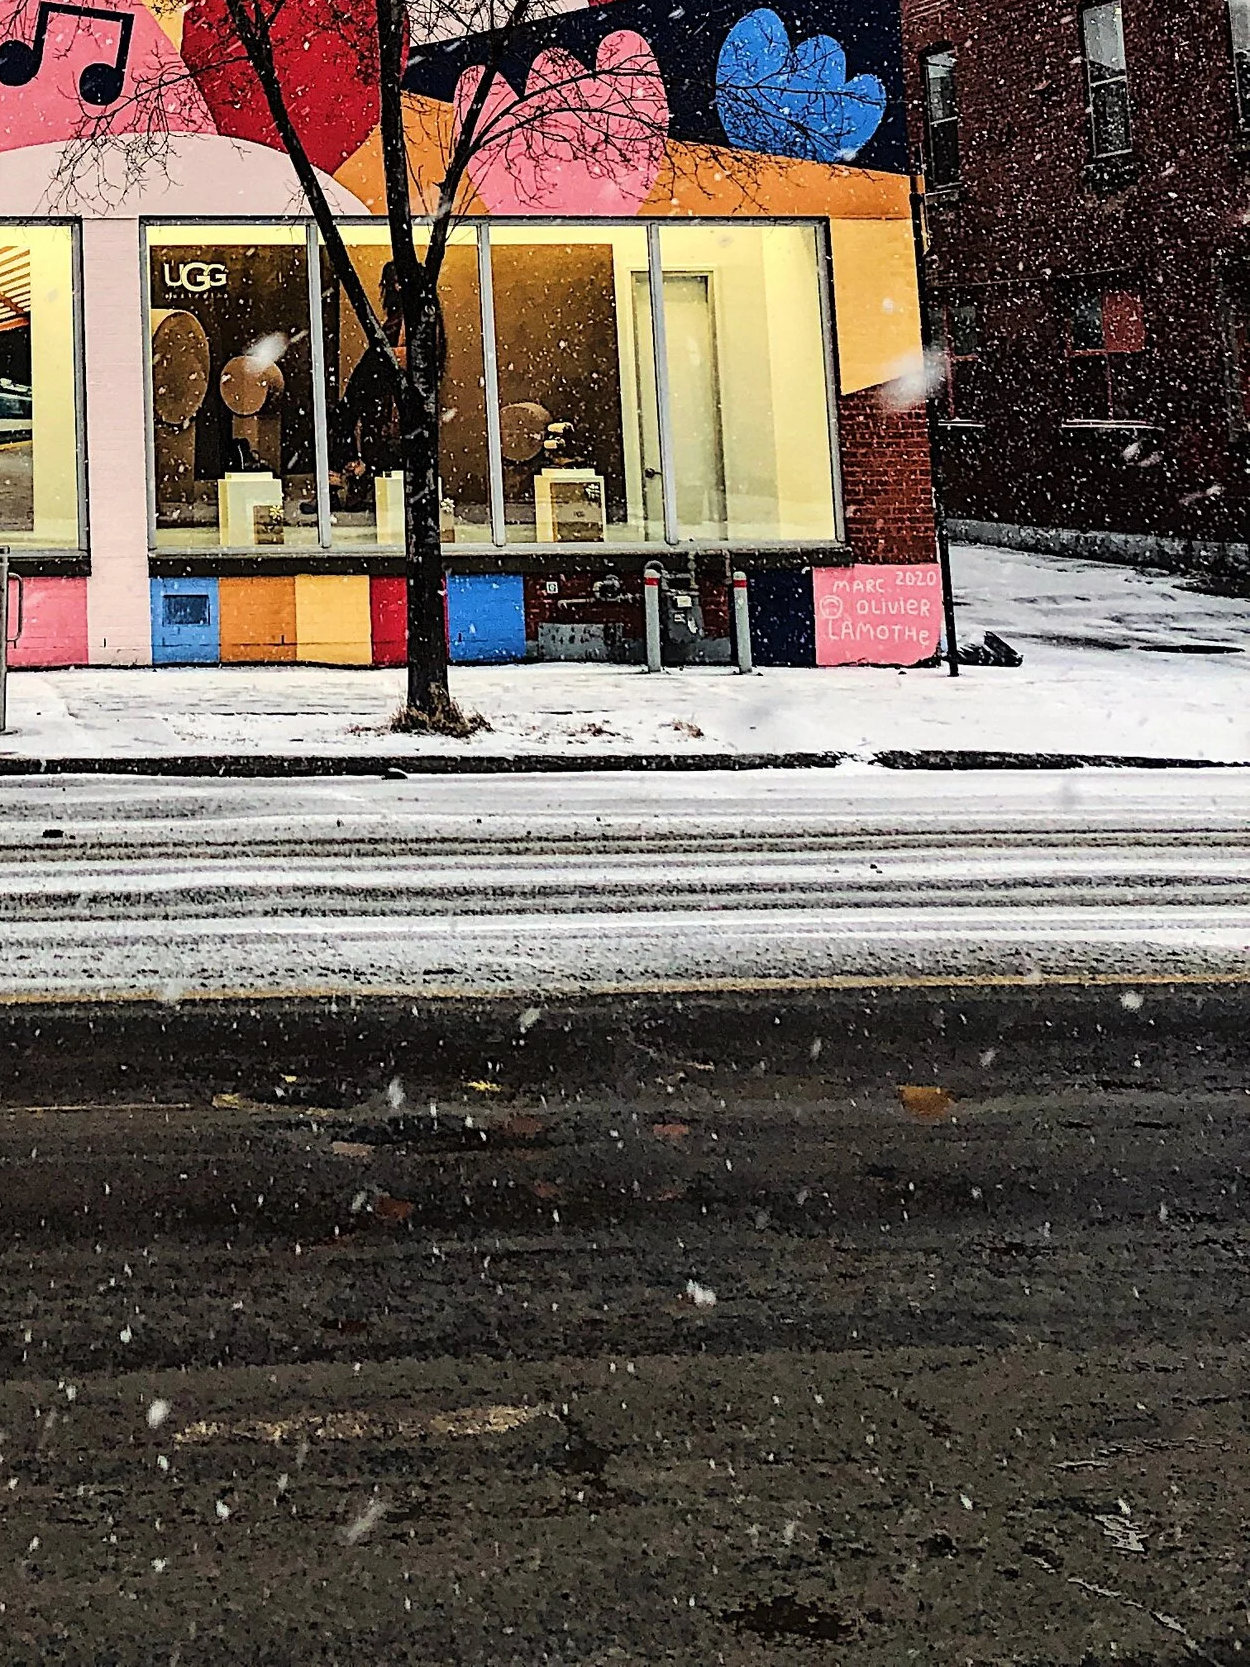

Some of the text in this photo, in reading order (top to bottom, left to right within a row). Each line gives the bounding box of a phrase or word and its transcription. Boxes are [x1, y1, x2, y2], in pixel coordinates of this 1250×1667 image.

[164, 262, 227, 292] UGG
[833, 571, 937, 593] MARC 2020
